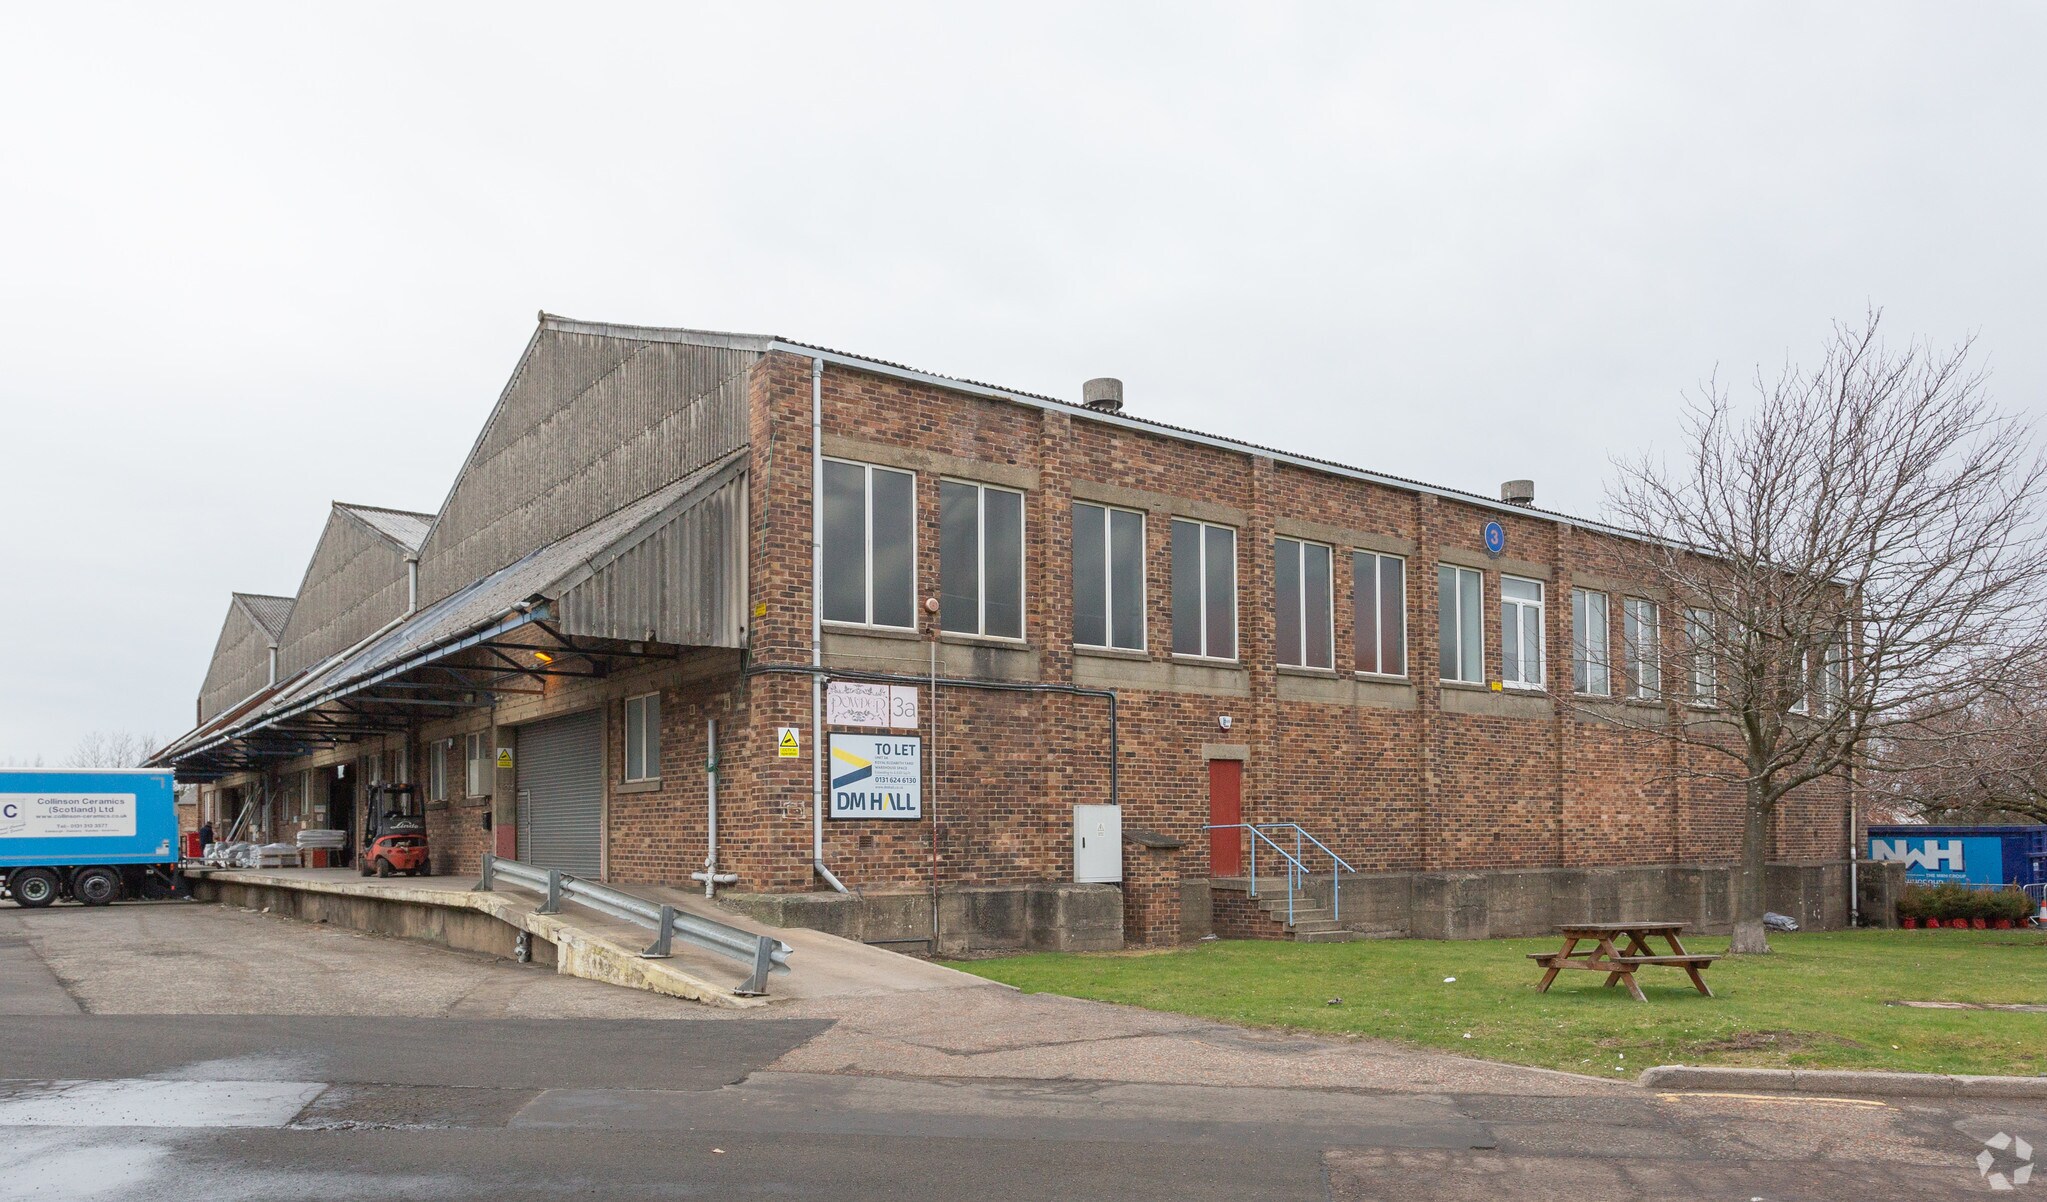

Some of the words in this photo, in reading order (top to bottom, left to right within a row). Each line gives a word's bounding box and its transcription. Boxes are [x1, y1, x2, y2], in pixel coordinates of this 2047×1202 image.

[1490, 529, 1499, 545] 3
[893, 696, 916, 718] 3a
[875, 743, 891, 755] TO
[894, 744, 916, 756] LET
[837, 792, 866, 810] DM
[870, 792, 916, 810] HALL
[3, 804, 18, 818] C
[48, 806, 97, 814] (Scotland)
